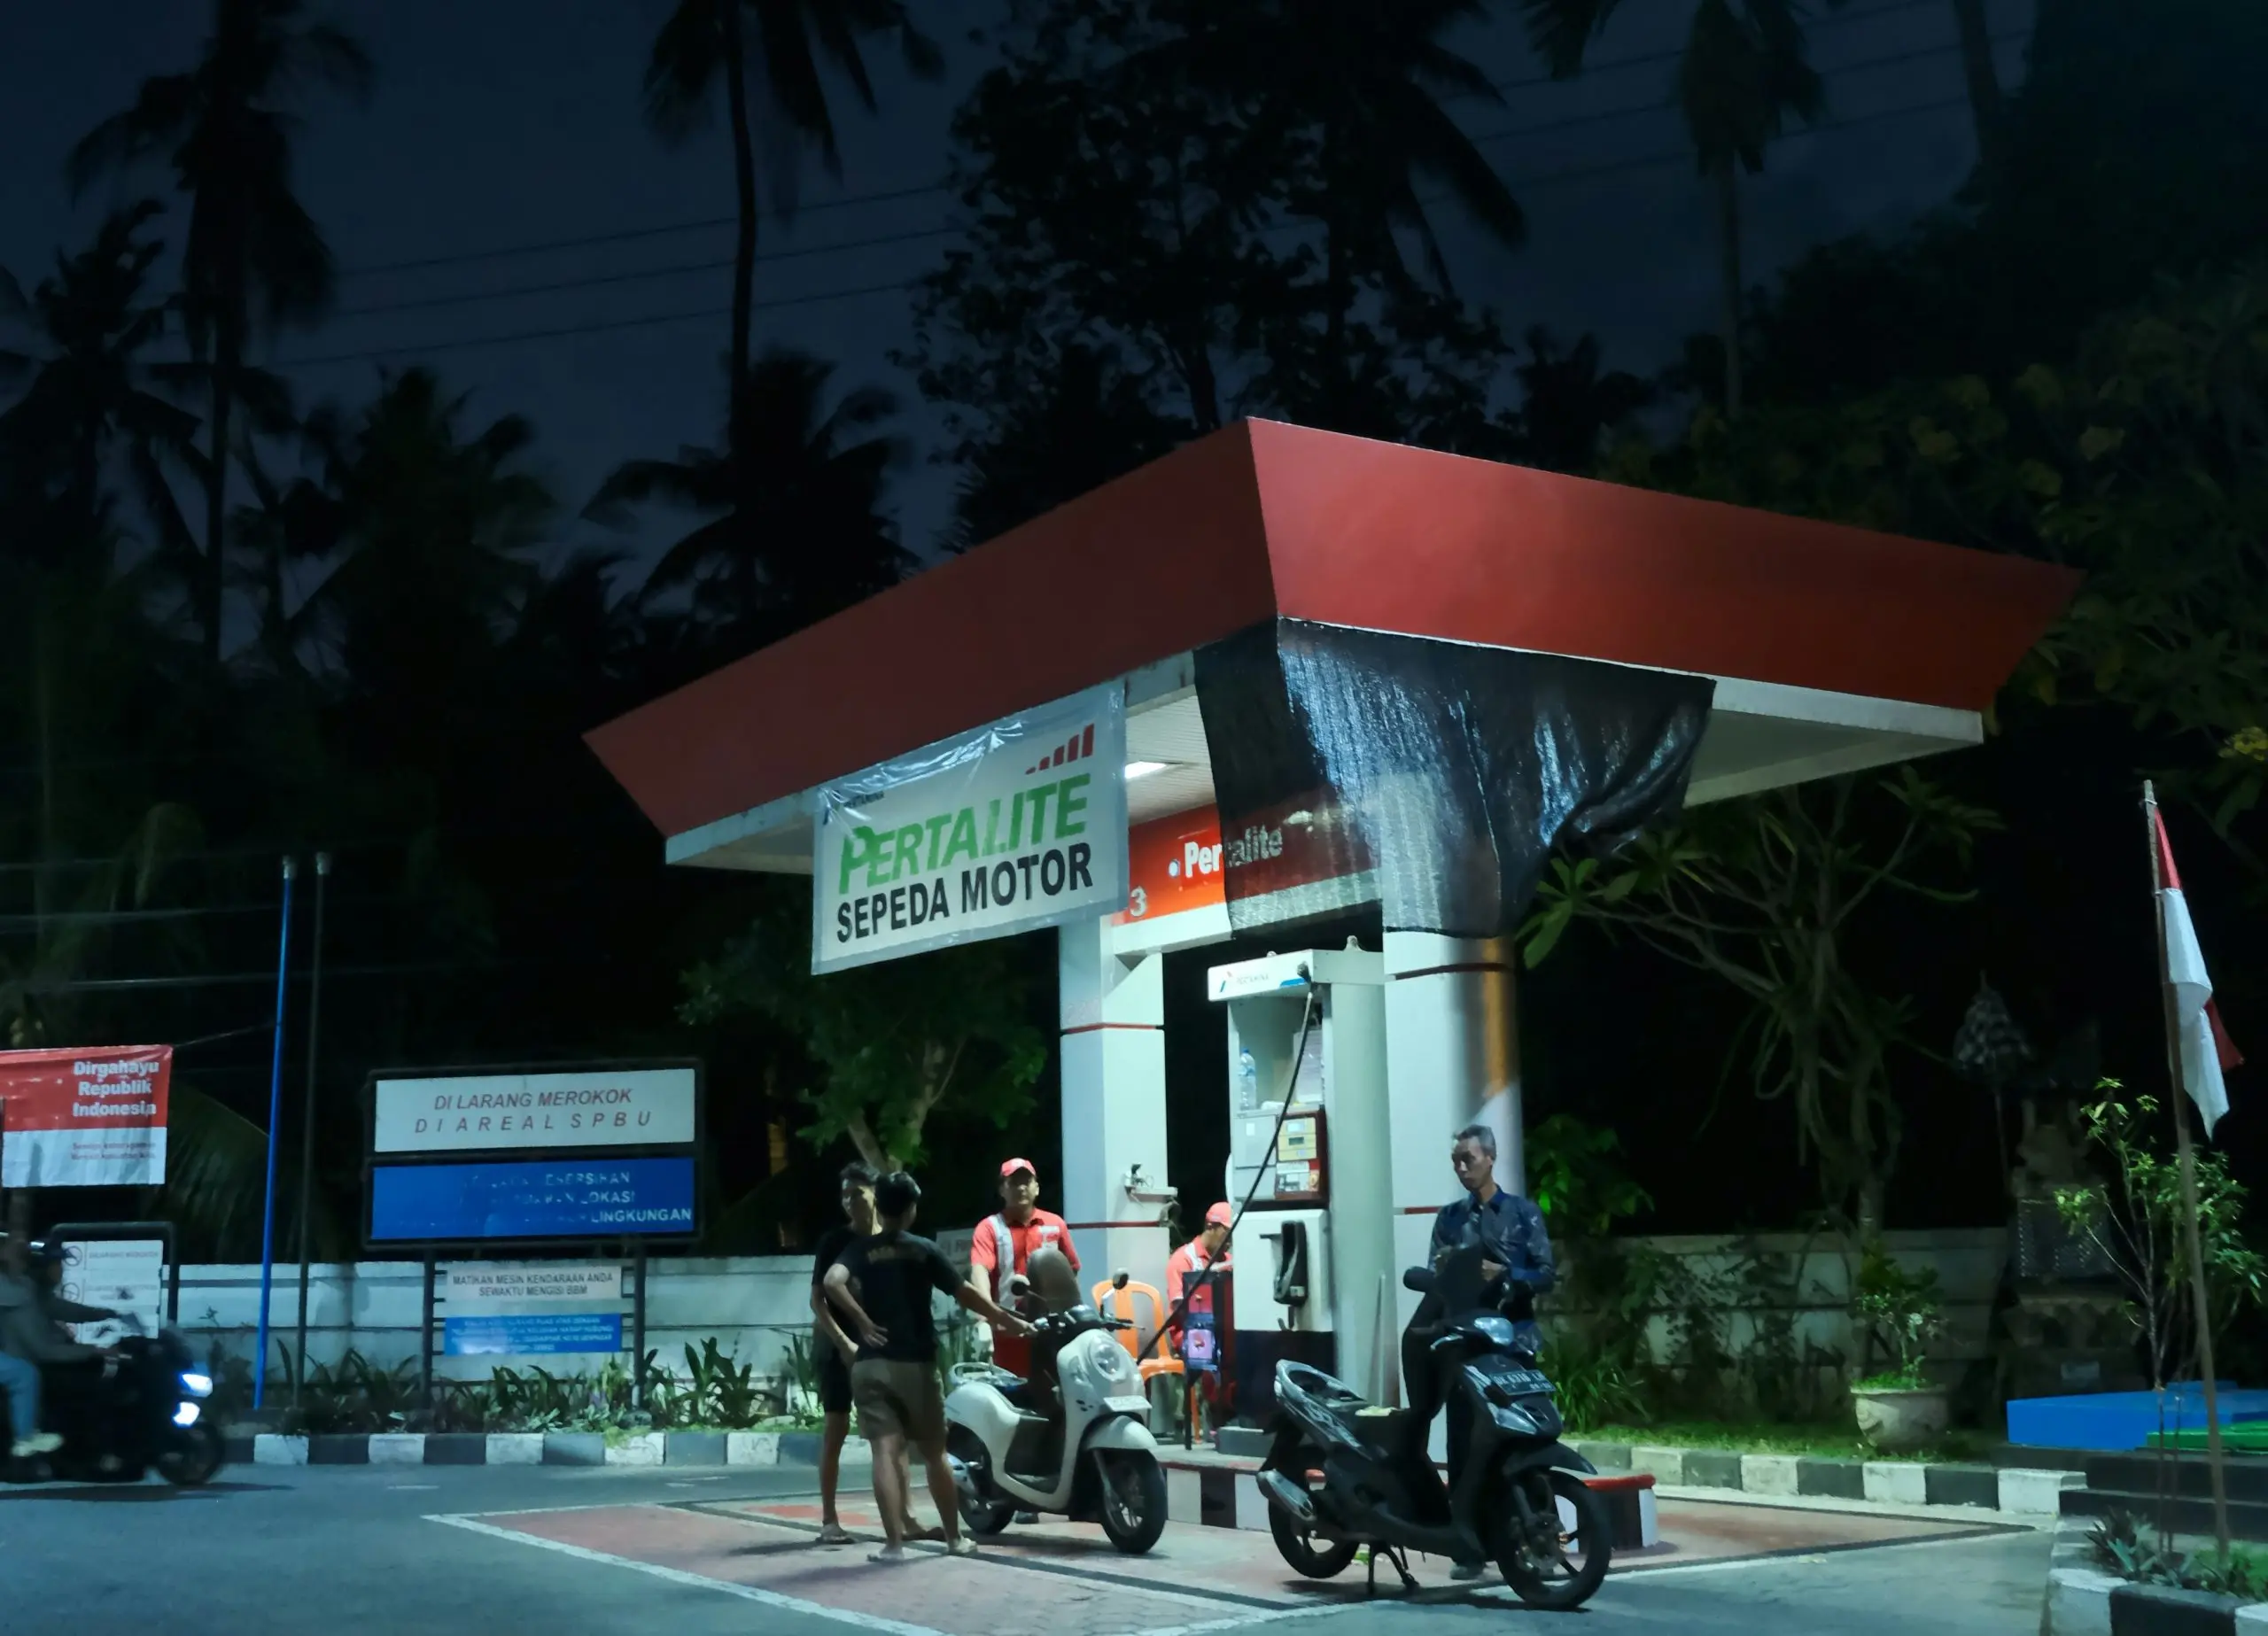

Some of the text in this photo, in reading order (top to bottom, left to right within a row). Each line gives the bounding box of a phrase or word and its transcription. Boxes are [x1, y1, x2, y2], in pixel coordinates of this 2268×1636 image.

[838, 772, 1091, 895] PERTALITE
[837, 842, 1093, 943] SEPEDA MOTOR
[1130, 886, 1147, 917] 3
[74, 1059, 159, 1078] Dirgahayu
[78, 1079, 152, 1098] Republik
[538, 1089, 633, 1107] MEROKOK
[73, 1100, 157, 1116] Indonesia
[570, 1111, 652, 1129] SPBU
[591, 1207, 692, 1224] LINGKUNGAN
[453, 1273, 613, 1285] MATIKAN MESIN KENDARAAN ANDA
[478, 1285, 587, 1297] SEWAKTU MENGISI BBM
